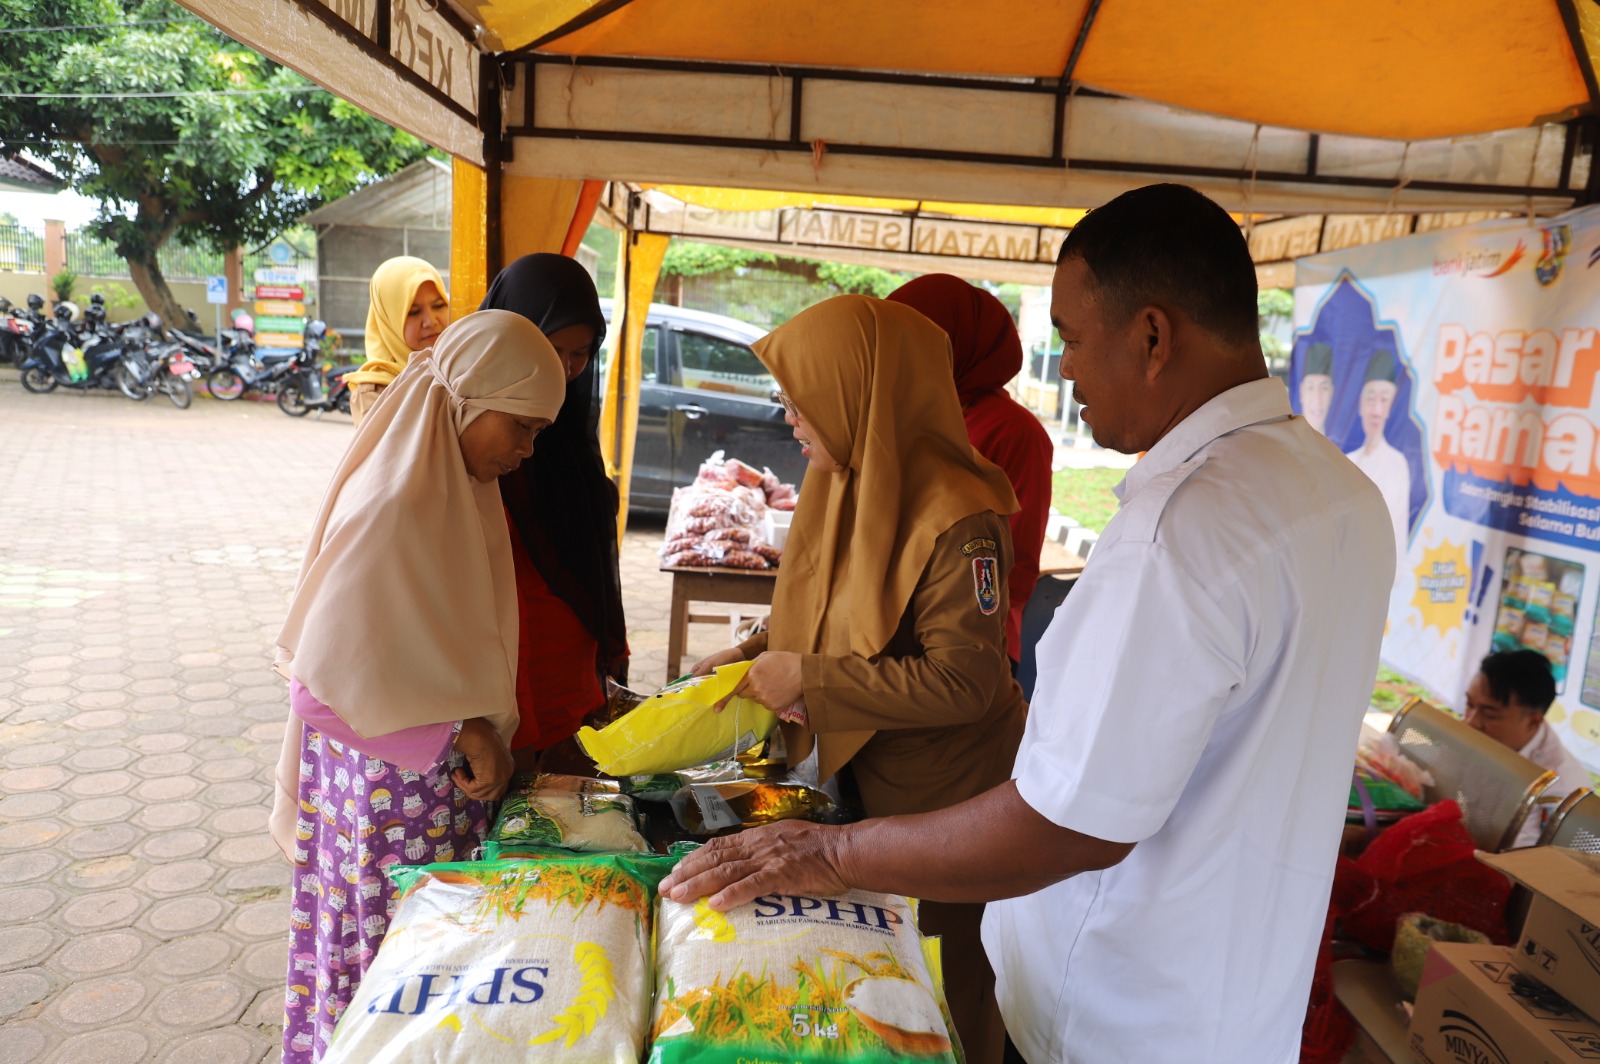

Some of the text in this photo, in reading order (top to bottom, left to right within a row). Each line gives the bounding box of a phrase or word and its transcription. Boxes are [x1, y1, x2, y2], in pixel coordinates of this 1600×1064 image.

[1433, 322, 1598, 389] Pasar
[1433, 393, 1600, 477] Rama
[754, 892, 904, 932] SPHP
[791, 1013, 839, 1040] 5 kg
[1443, 1033, 1496, 1064] MINYA
